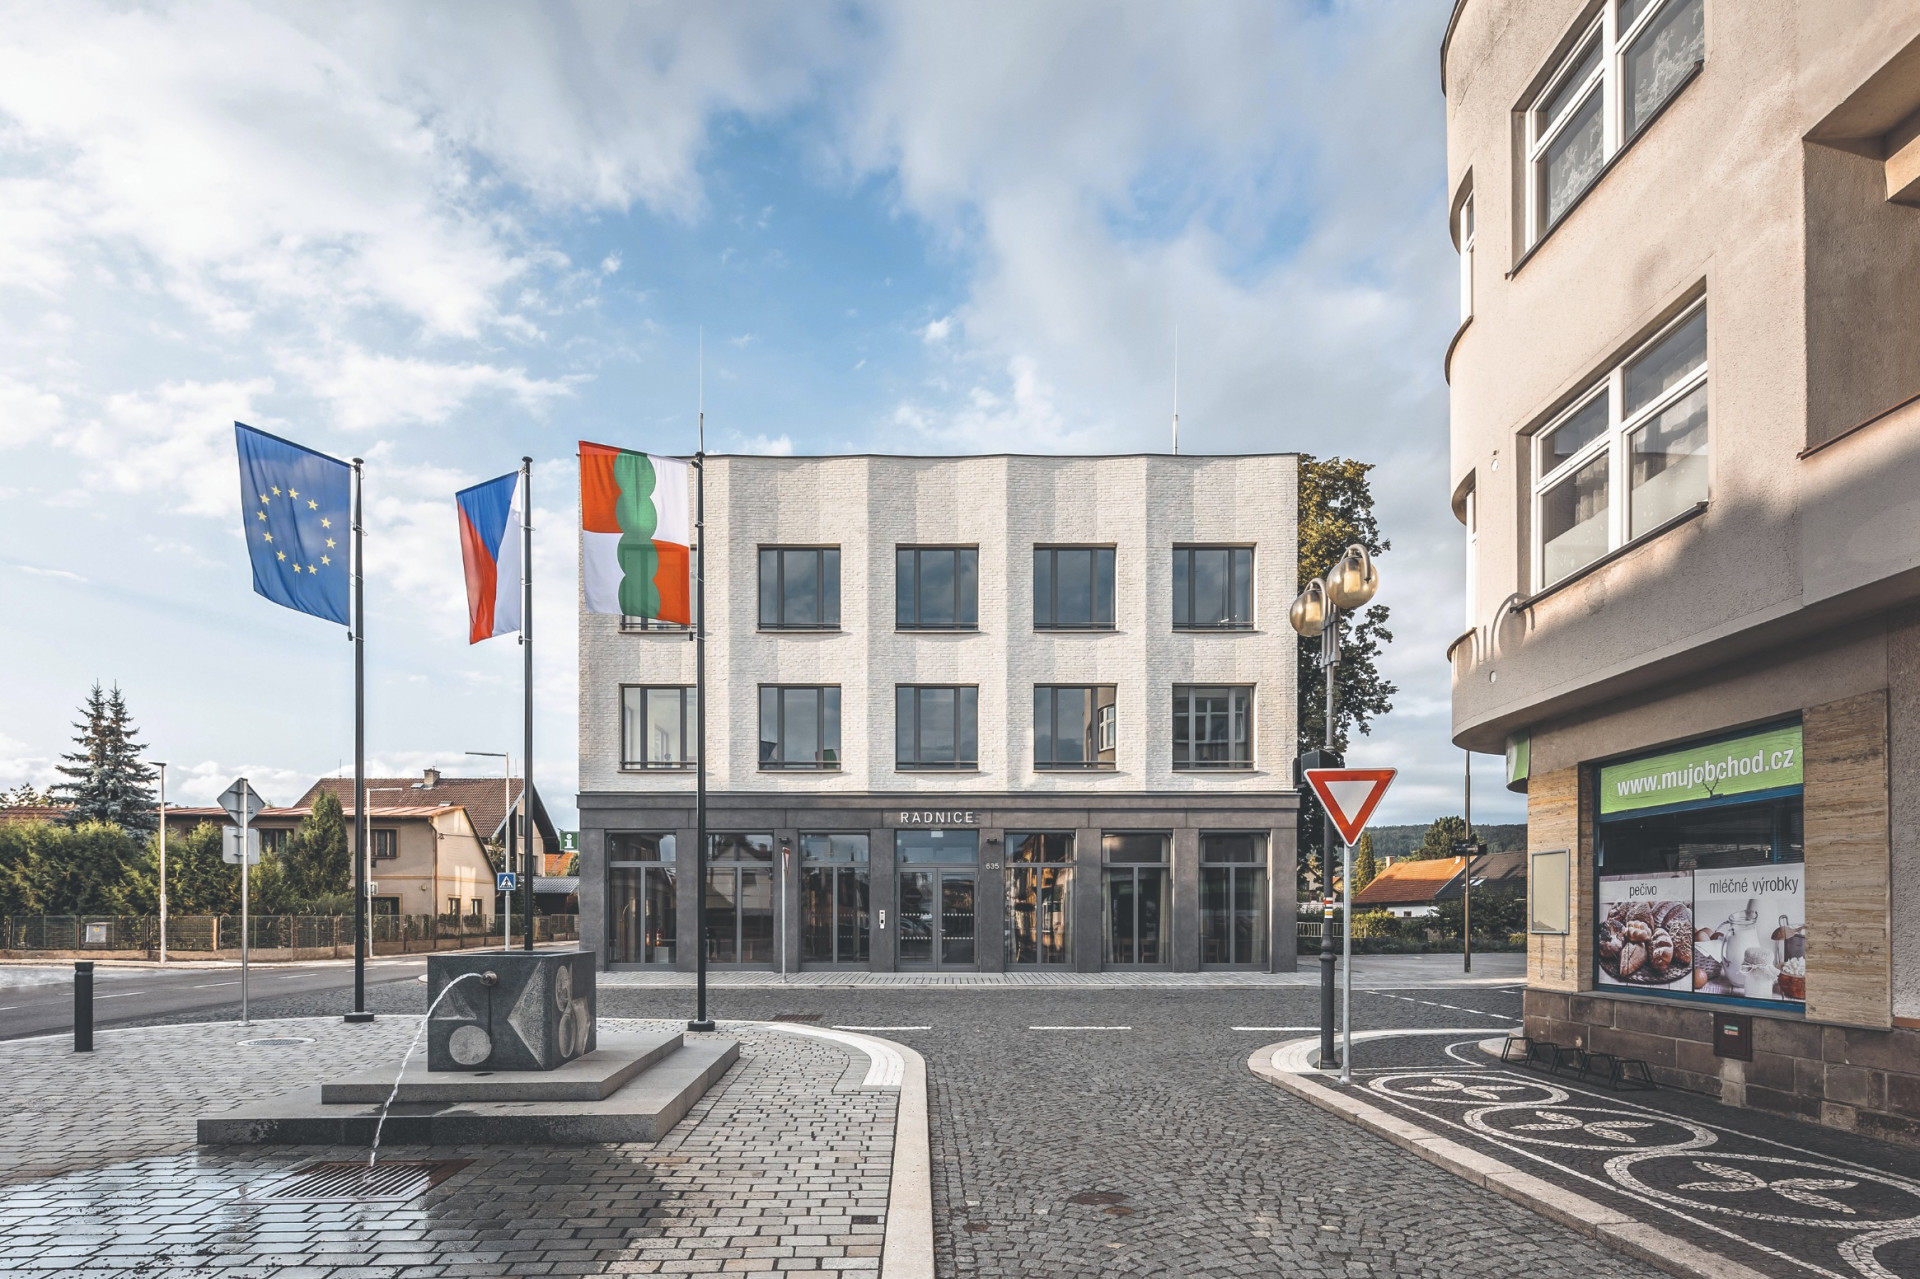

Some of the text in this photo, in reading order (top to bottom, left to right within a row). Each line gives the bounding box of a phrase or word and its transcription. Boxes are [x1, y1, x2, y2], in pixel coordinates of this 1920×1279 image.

[1617, 749, 1794, 796] www.mujobchod.cz
[900, 811, 974, 824] RADNICE
[985, 862, 1000, 870] 635
[1629, 883, 1657, 898] pečivo
[1709, 875, 1799, 896] mléčné výrobky
